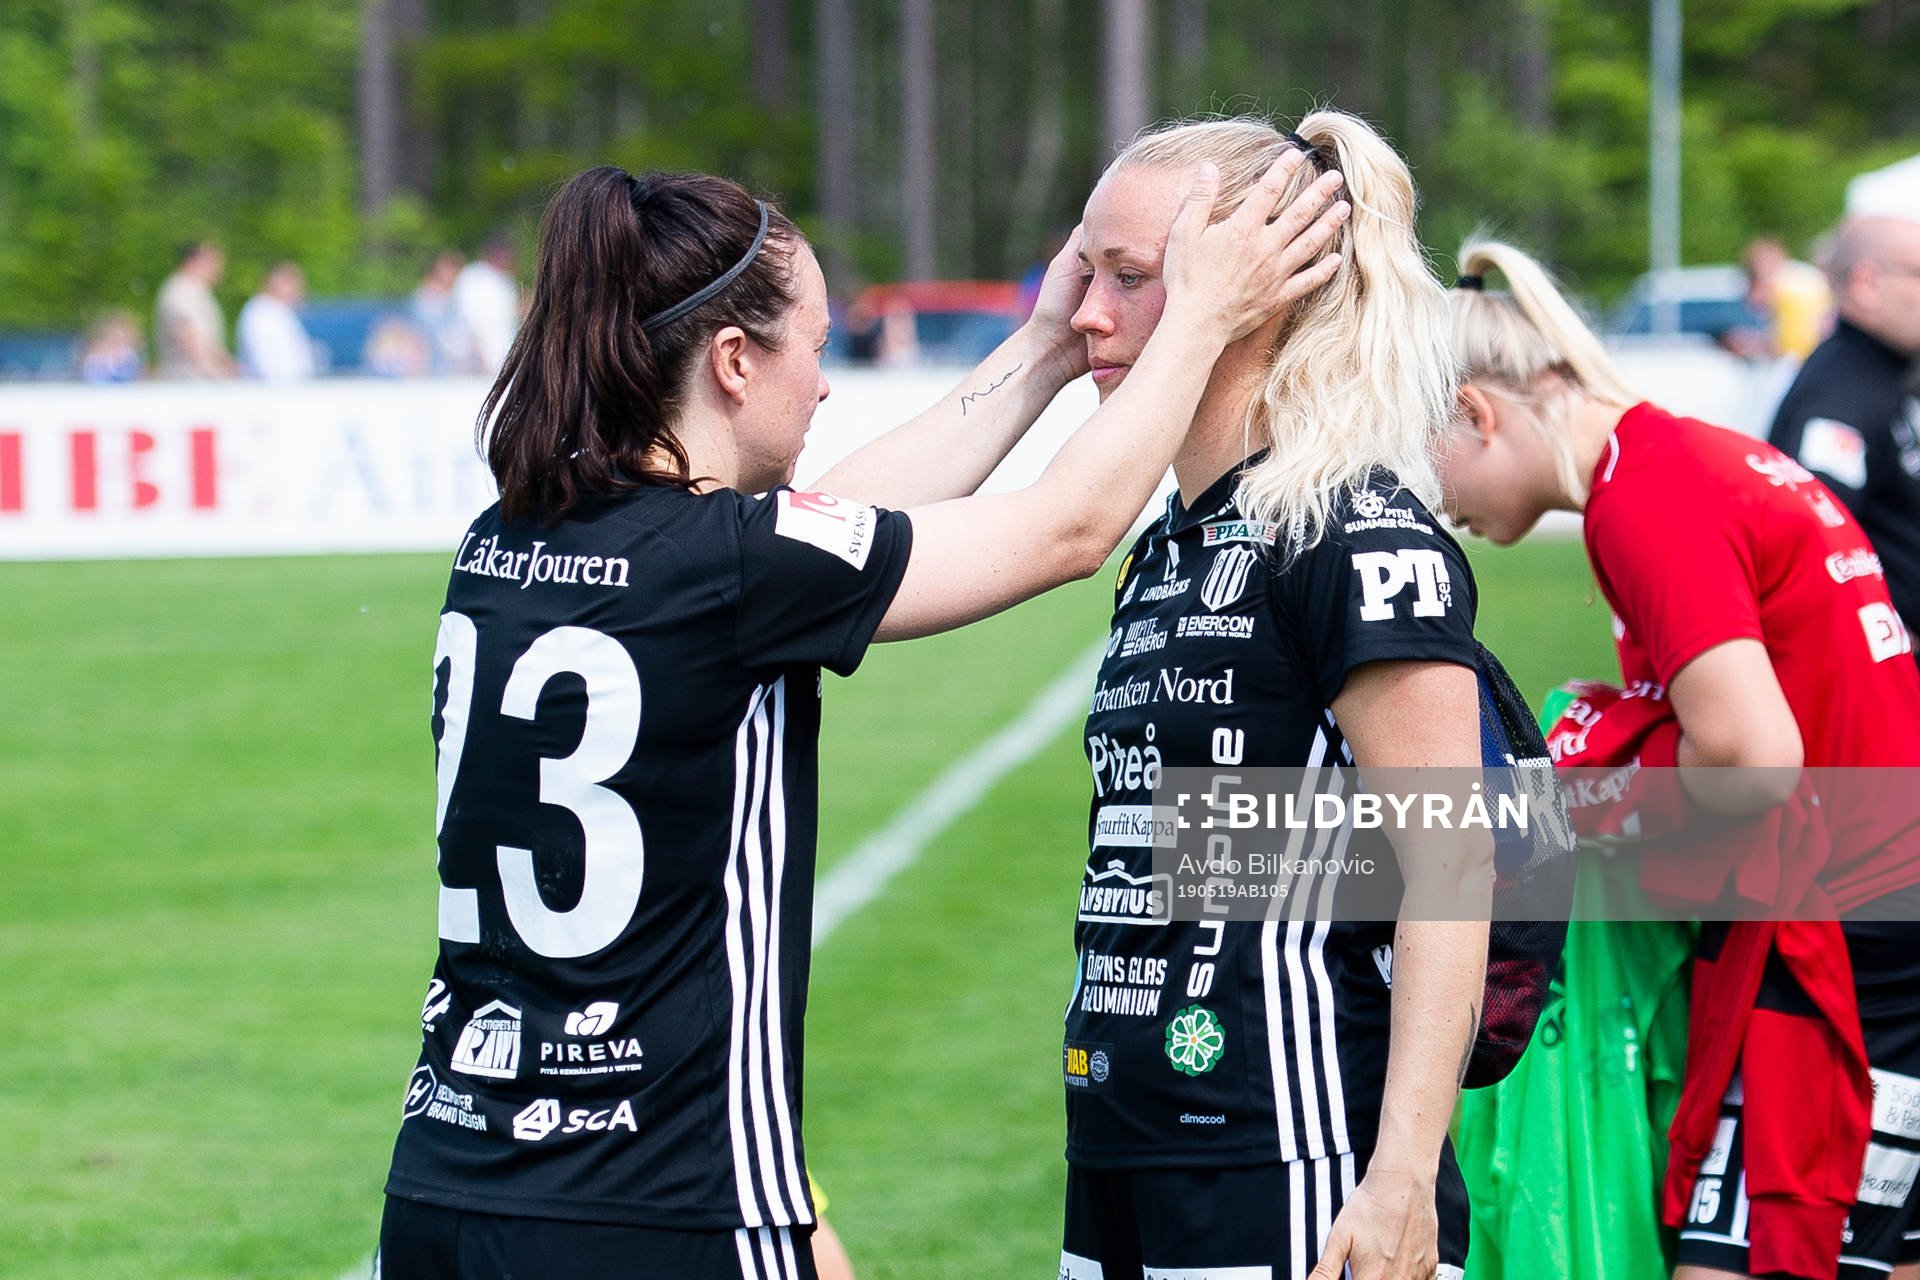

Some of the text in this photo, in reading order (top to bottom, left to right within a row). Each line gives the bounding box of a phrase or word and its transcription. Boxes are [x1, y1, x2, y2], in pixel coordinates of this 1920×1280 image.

[1344, 518, 1434, 535] SUMMER GAMES
[454, 532, 630, 590] LäkarJouren
[1139, 578, 1191, 602] LINDBÄCKS
[1351, 548, 1450, 621] PT
[1187, 615, 1255, 632] ENERCON
[1133, 630, 1169, 655] ENERGI
[1152, 667, 1235, 705] Nord
[1088, 722, 1163, 798] Piteå
[432, 611, 645, 959] 23
[1128, 956, 1168, 986] GLAS
[540, 1038, 643, 1062] PIREVA
[427, 1101, 487, 1131] BRAND DESIGN
[1179, 1113, 1226, 1125] climacool
[1688, 1178, 1722, 1224] 15
